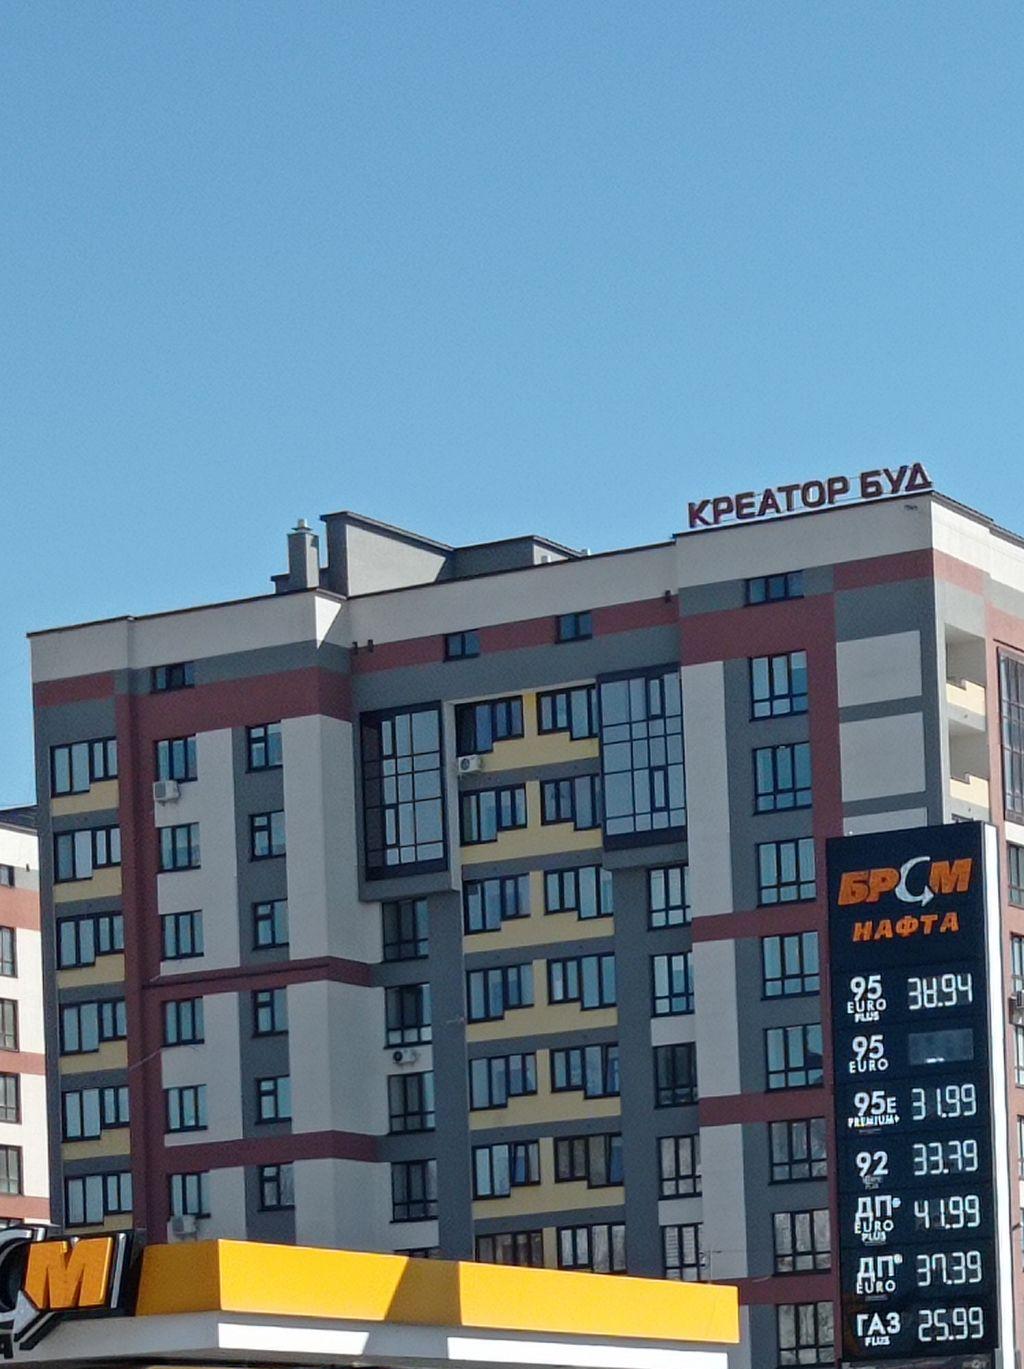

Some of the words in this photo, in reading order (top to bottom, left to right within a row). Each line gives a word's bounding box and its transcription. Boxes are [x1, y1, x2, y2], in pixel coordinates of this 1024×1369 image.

[687, 474, 851, 529] КРЕАТОР
[860, 462, 933, 499] БУД
[838, 856, 973, 907] БРСМ
[853, 912, 960, 942] НАФТА
[850, 975, 883, 1001] 95
[847, 998, 887, 1014] EURO
[854, 1011, 880, 1023] PLUS
[852, 1034, 885, 1062] 95
[849, 1058, 889, 1074] EURO
[911, 1083, 978, 1121] 31.99
[855, 1150, 889, 1178] 92
[914, 1195, 981, 1229] 41.99
[854, 1219, 895, 1235] EURO
[917, 1251, 983, 1287] 37.39
[856, 1279, 897, 1295] EURO
[856, 1311, 902, 1337] ГАЗ
[918, 1306, 985, 1342] 25.99
